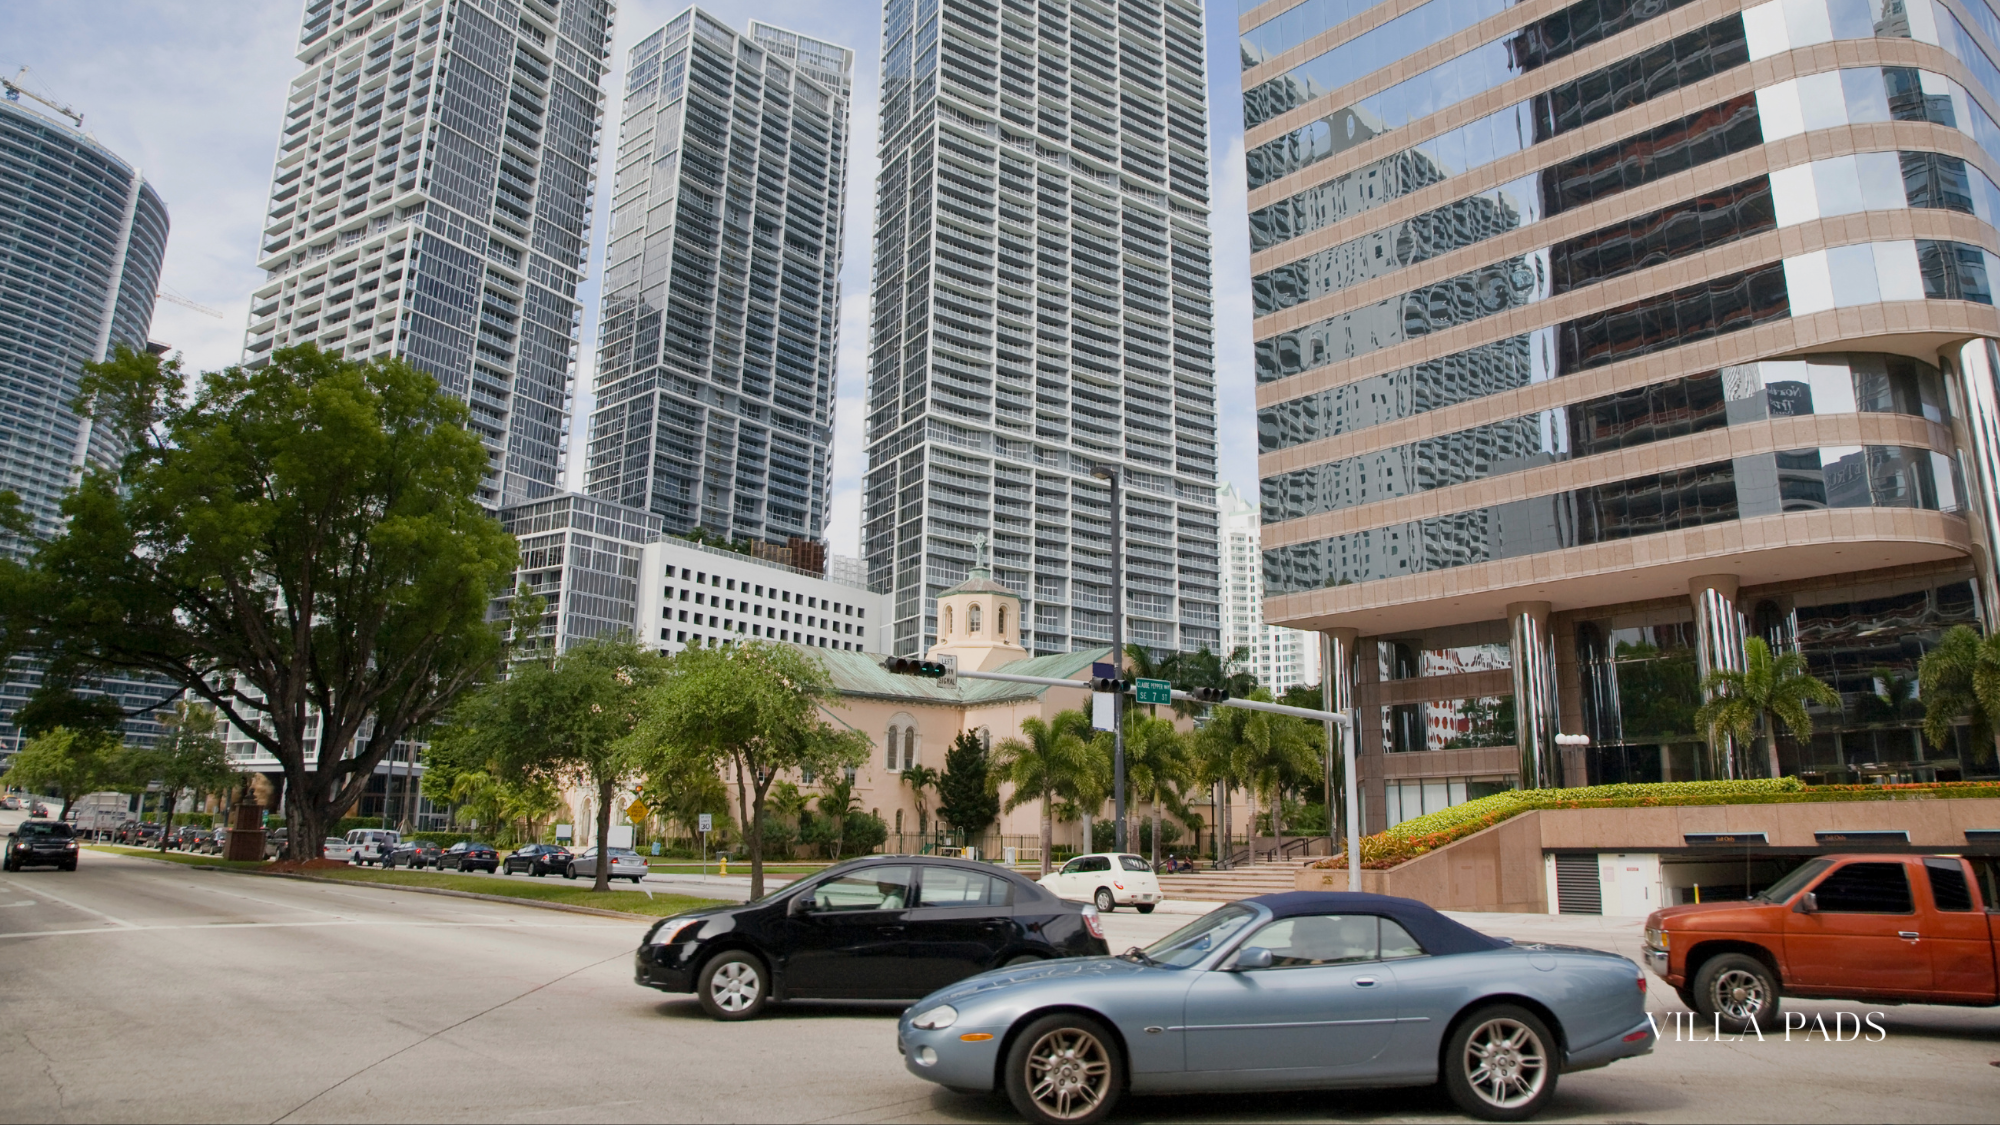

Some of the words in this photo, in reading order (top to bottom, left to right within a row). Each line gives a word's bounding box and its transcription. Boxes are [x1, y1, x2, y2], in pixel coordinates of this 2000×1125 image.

[938, 677, 955, 685] SIGNAL
[1137, 681, 1150, 689] CLAUDE
[1150, 682, 1163, 690] PEPPER
[1139, 691, 1147, 700] SE
[1152, 691, 1157, 701] 7
